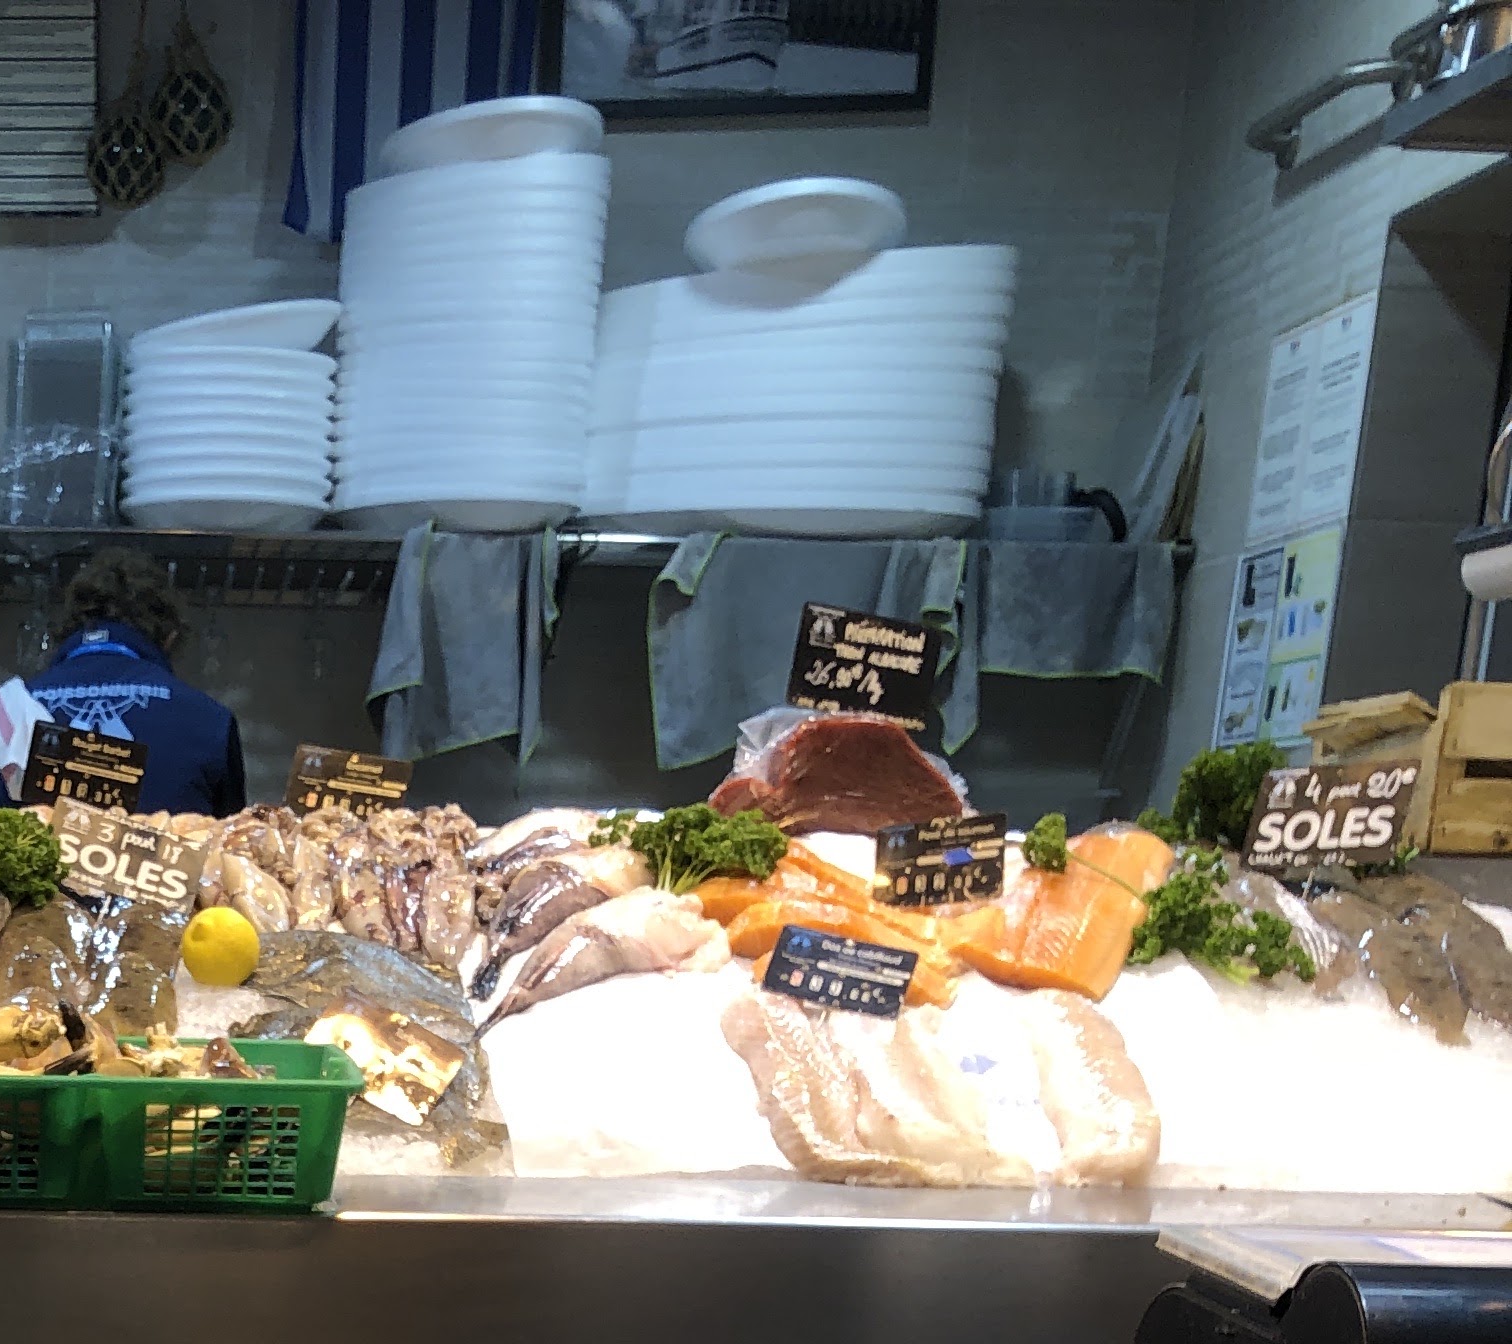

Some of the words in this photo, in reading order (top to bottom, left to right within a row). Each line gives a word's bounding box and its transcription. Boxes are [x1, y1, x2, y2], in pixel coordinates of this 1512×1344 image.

[1305, 773, 1322, 805] 4
[97, 823, 115, 843] 3
[1252, 804, 1396, 852] SOLES
[58, 833, 189, 900] SOLES
